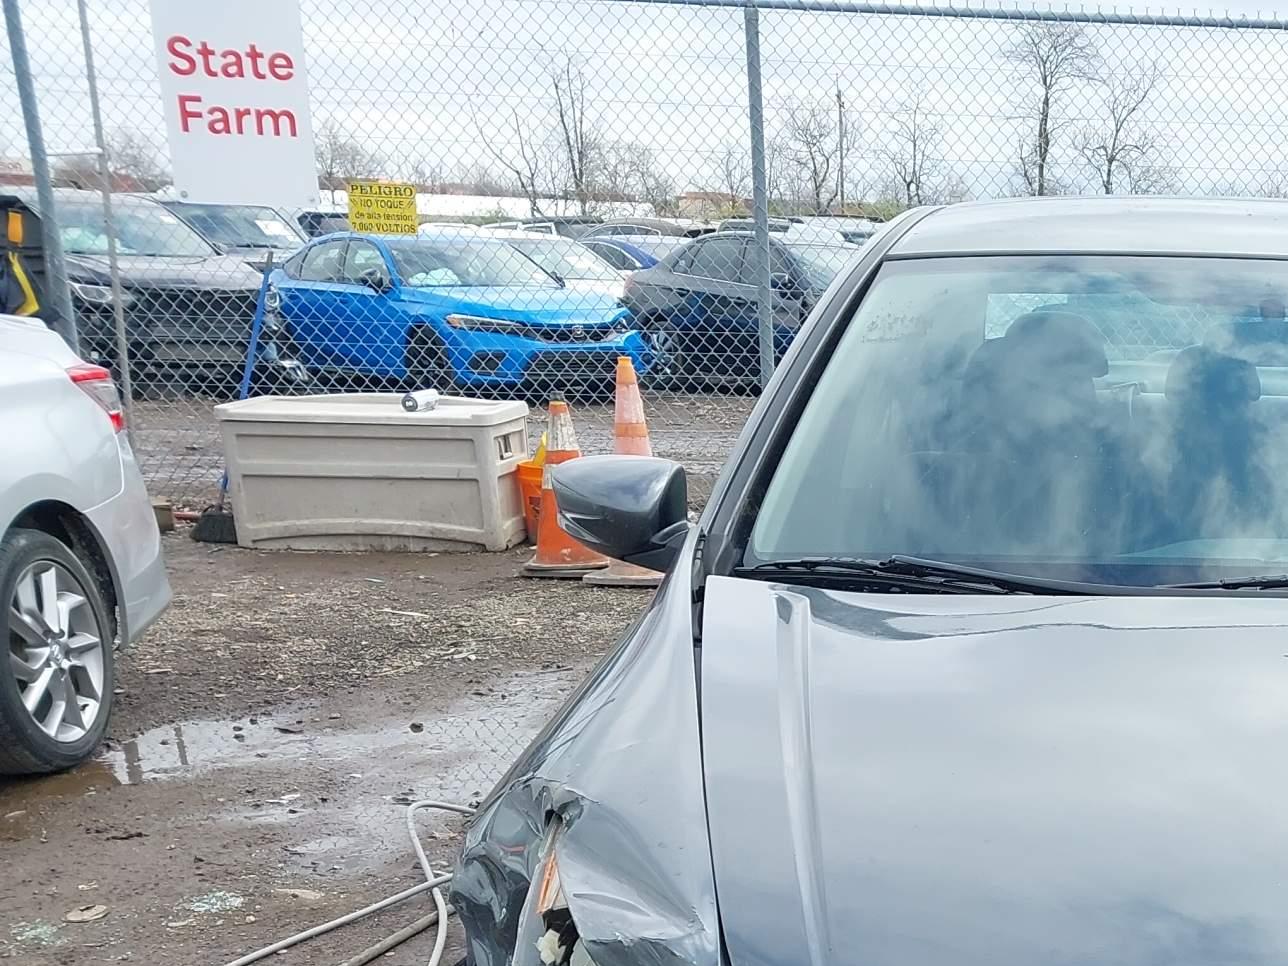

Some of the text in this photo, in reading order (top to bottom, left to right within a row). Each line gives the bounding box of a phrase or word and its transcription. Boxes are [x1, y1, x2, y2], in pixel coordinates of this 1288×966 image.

[167, 35, 294, 81] State
[177, 95, 298, 137] Farm
[350, 184, 413, 197] PELIGRO
[360, 198, 404, 209] NO TOQUE
[355, 211, 365, 219] de
[375, 222, 416, 233] VOLTIOS
